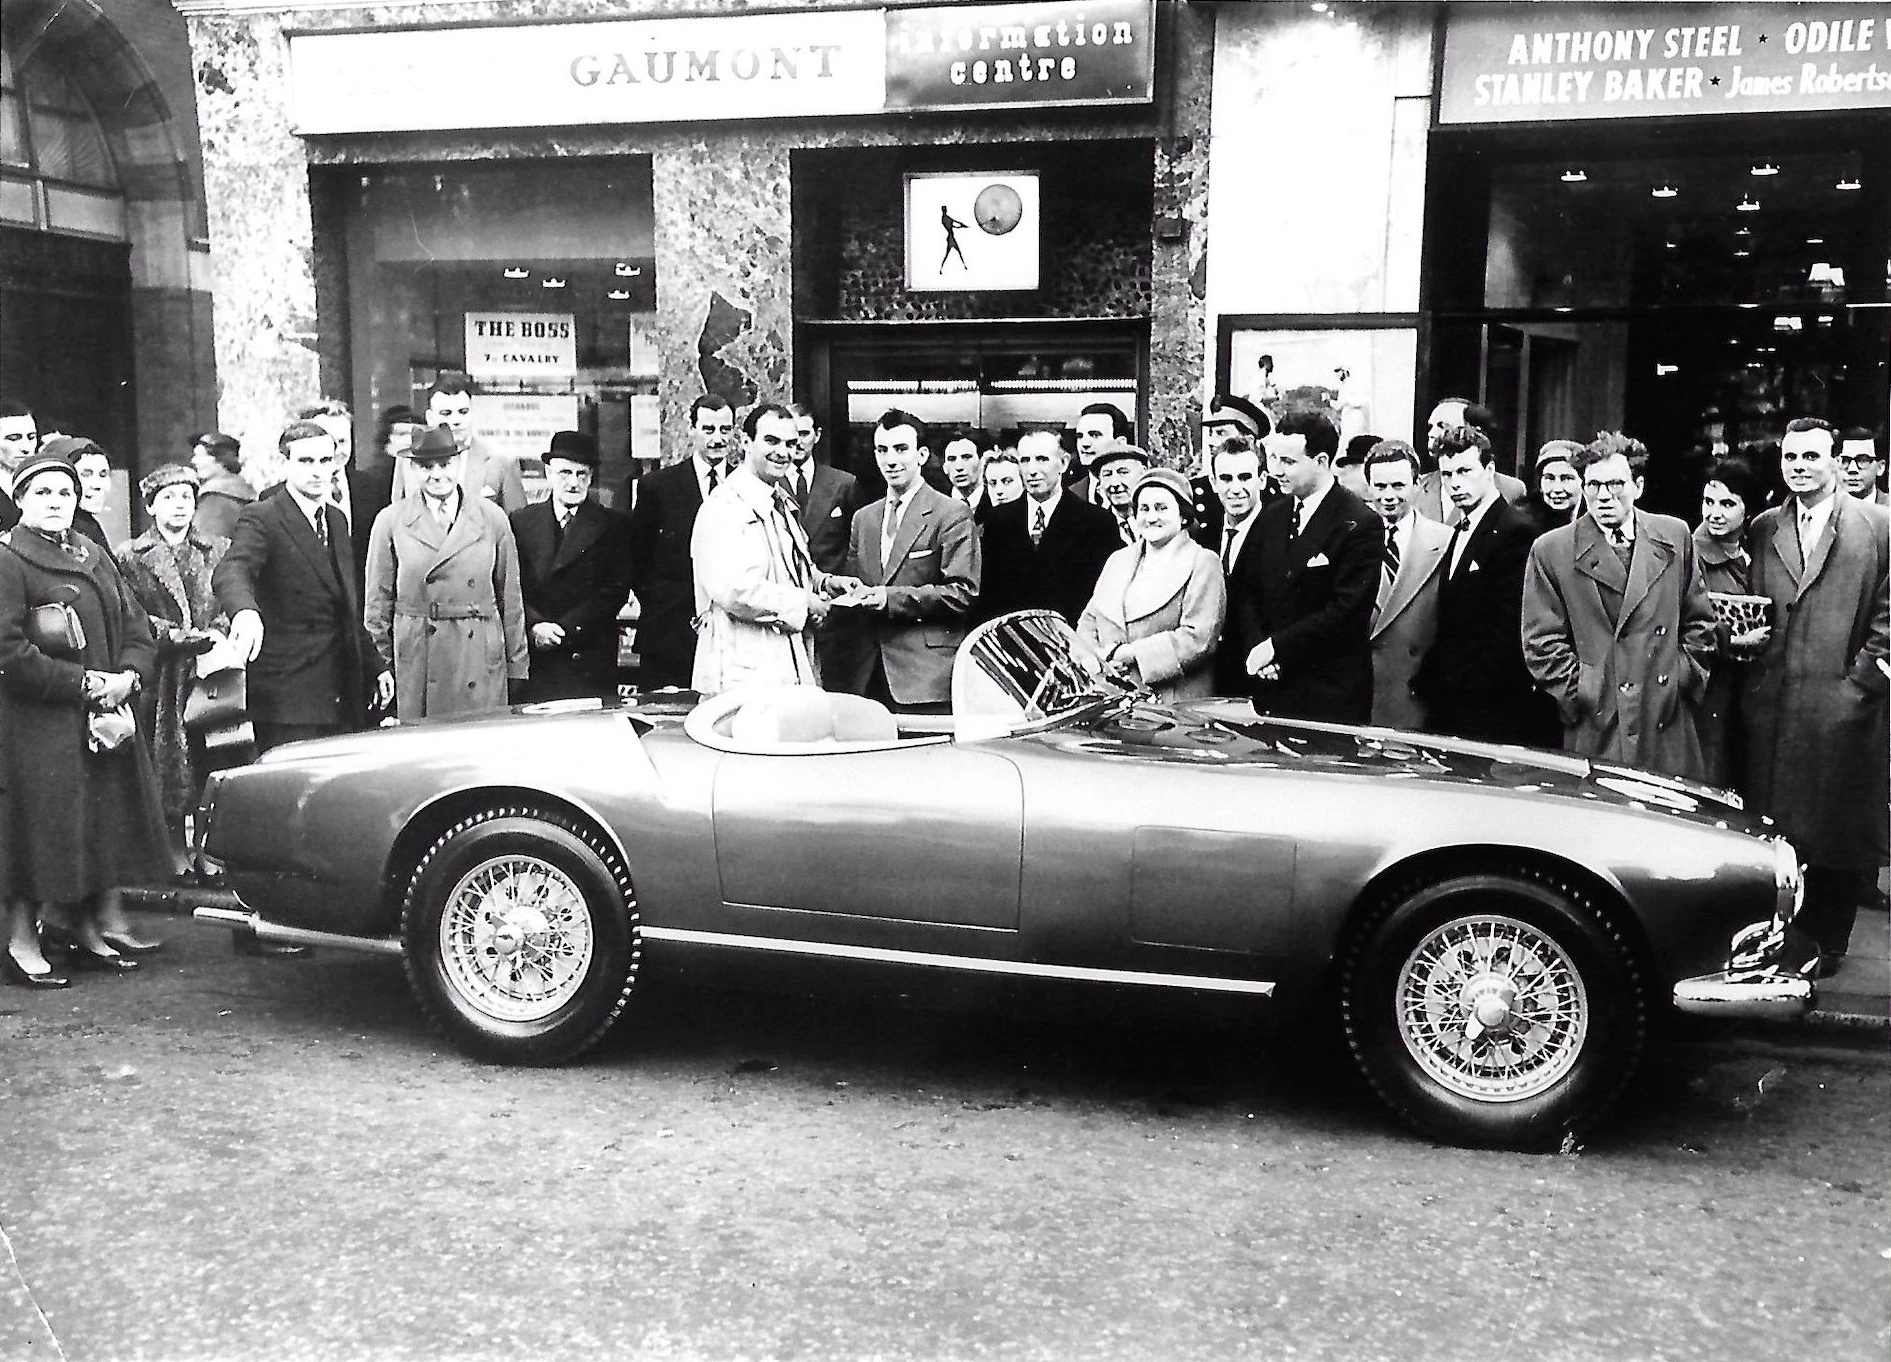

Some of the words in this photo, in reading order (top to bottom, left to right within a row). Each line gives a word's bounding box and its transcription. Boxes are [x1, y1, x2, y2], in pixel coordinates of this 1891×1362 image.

[899, 13, 1133, 54] information
[1508, 28, 1655, 65] ANTHONY
[1663, 25, 1743, 59] STEEL
[1784, 18, 1875, 55] ODILE
[570, 45, 842, 87] GAUMONT
[950, 53, 1077, 86] centre
[1473, 70, 1595, 107] STANLEY
[1603, 66, 1703, 101] BAKER
[1725, 65, 1793, 99] James
[475, 320, 515, 337] THE
[521, 321, 570, 339] BOSS
[502, 353, 559, 364] CAVALRY
